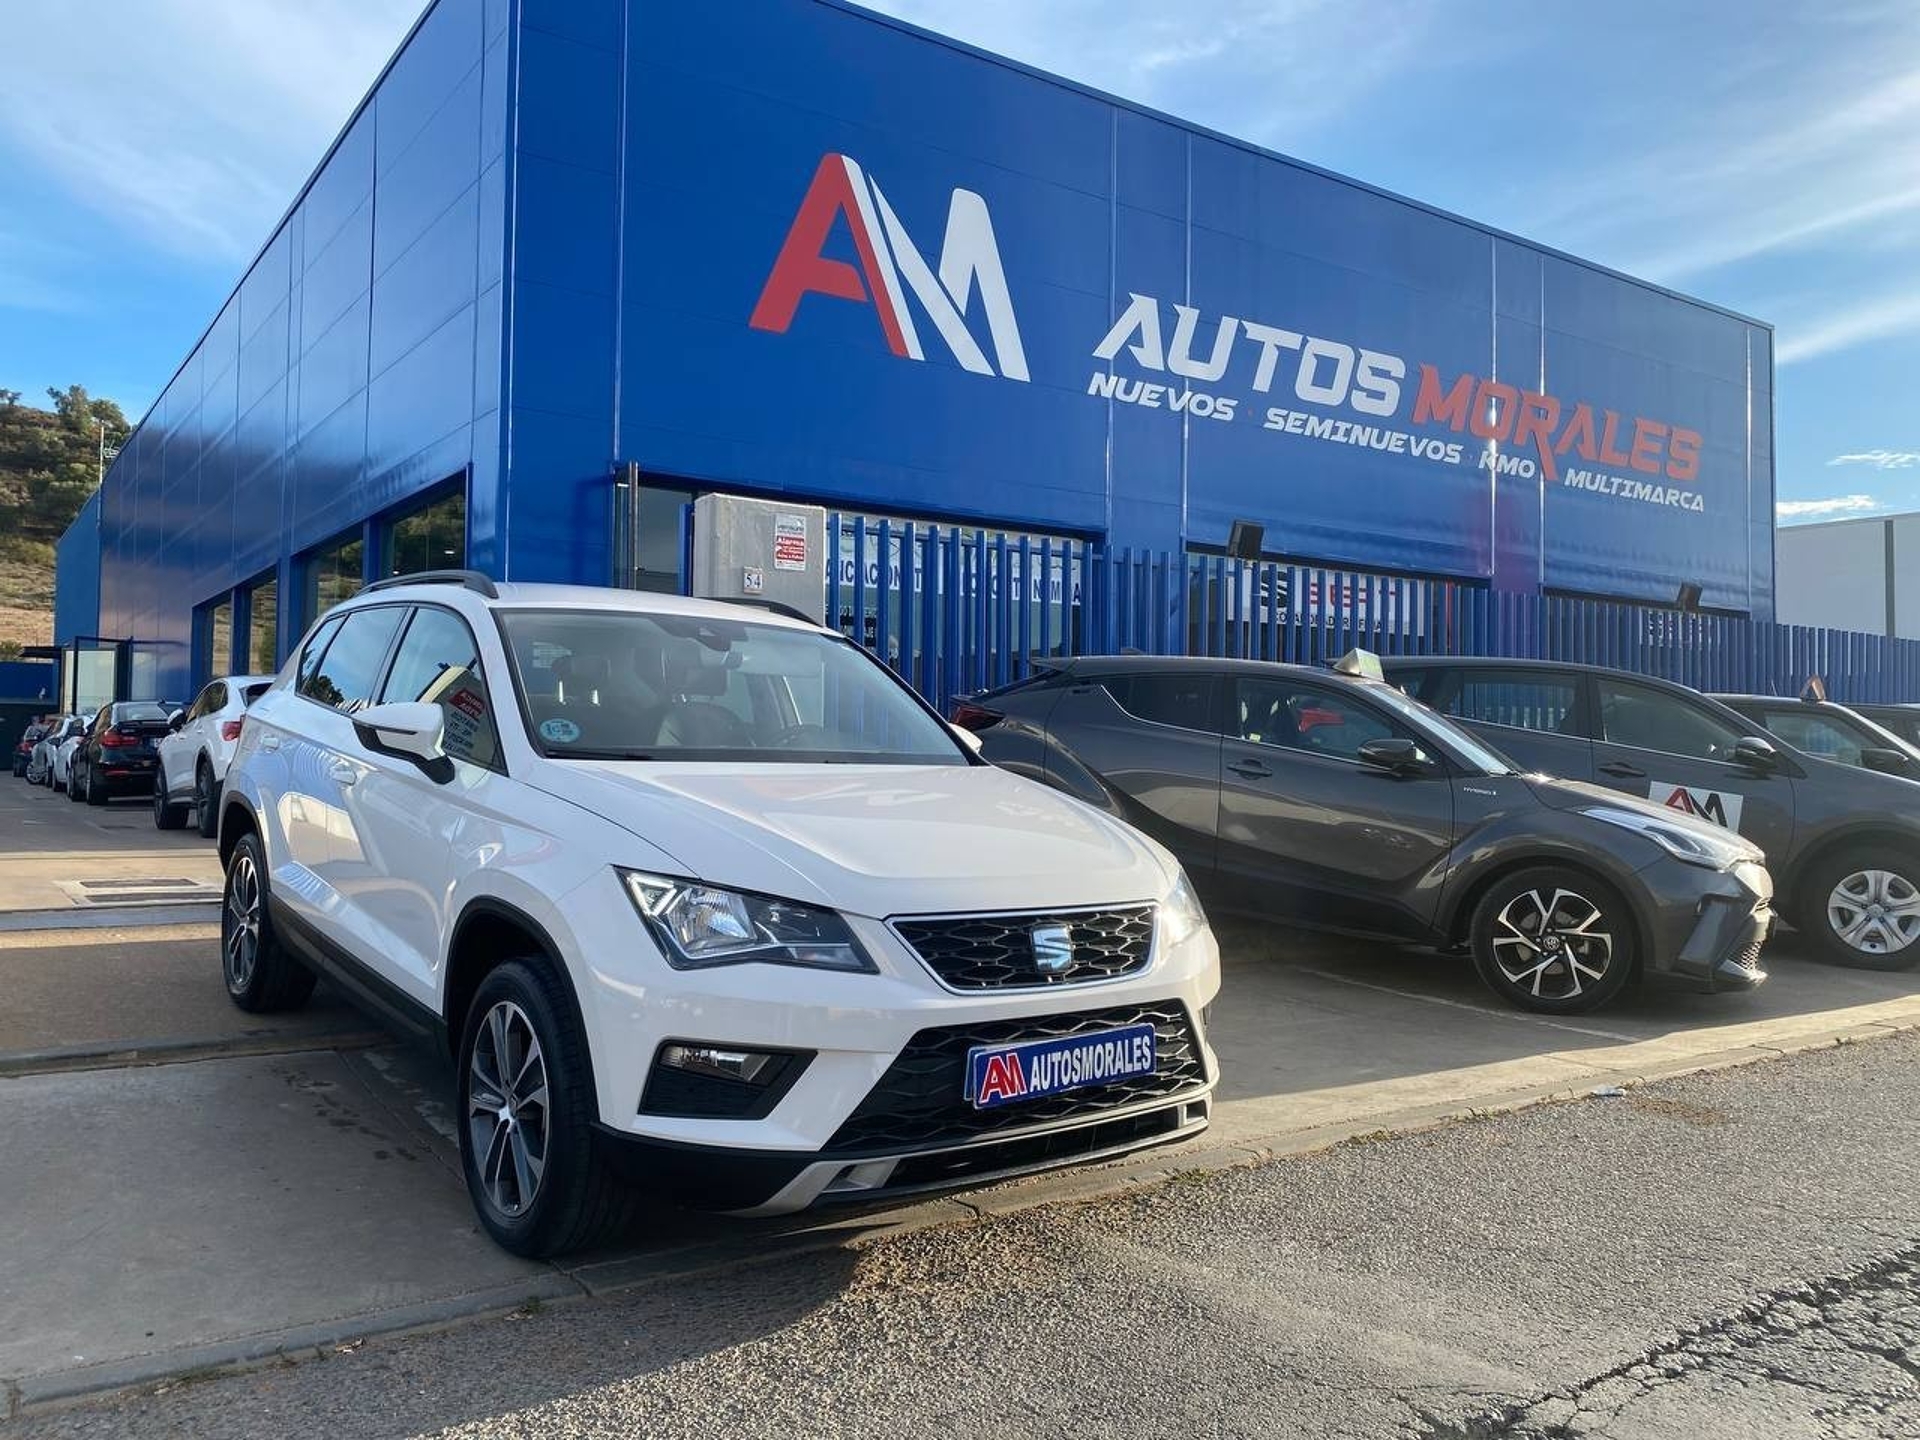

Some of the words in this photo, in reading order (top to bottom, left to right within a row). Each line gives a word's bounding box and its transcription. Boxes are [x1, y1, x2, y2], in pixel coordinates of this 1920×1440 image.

[1087, 372, 1239, 422] NUEVOS
[1263, 407, 1464, 464] SEMINUEVOS
[1564, 468, 1705, 512] MULTIMARCA
[1092, 292, 1406, 417] AUTOS
[1411, 364, 1704, 481] MORALES
[1030, 1035, 1151, 1092] AUTOSMORALES
